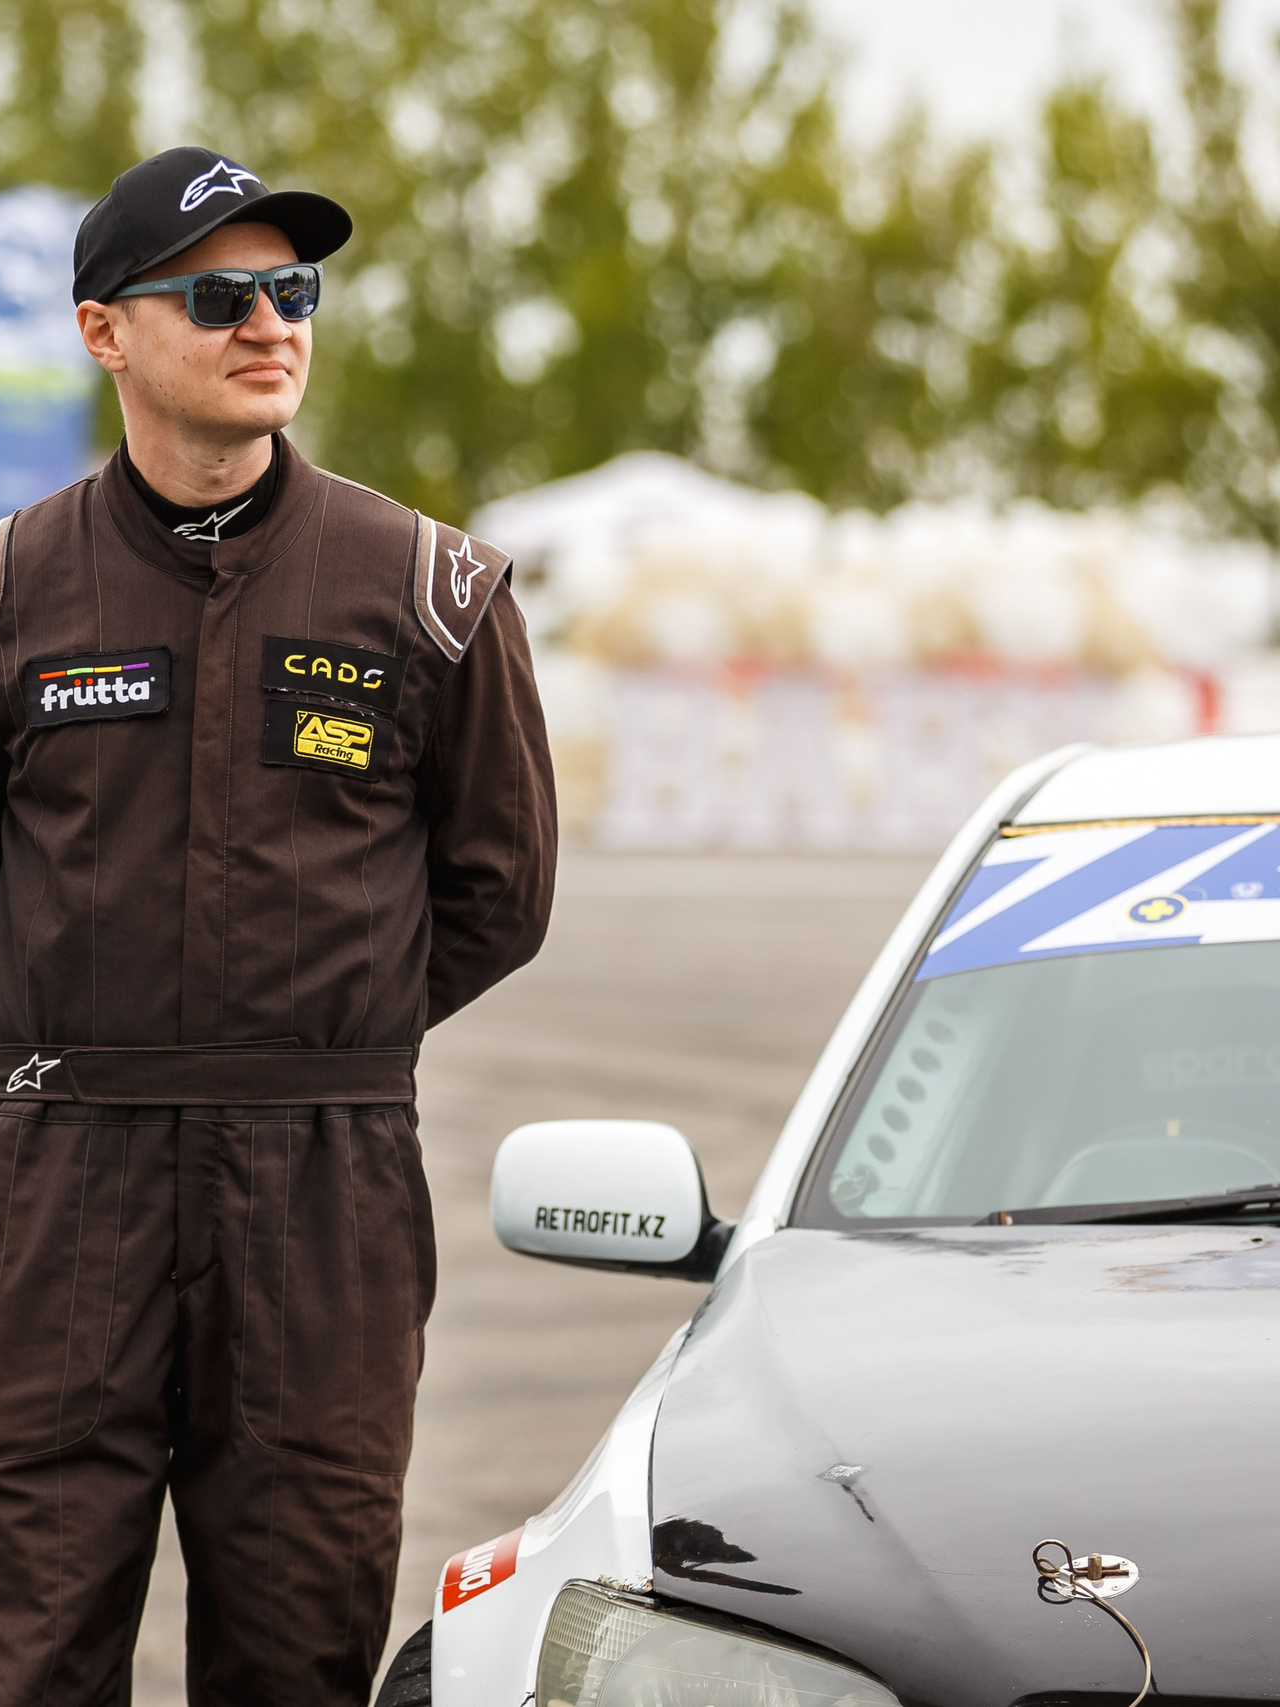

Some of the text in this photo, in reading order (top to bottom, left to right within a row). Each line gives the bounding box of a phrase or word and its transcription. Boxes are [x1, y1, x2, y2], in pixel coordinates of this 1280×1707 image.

[284, 654, 384, 690] CADS
[40, 677, 150, 712] frütta
[298, 715, 371, 748] ASP
[314, 743, 354, 762] Racing
[535, 1206, 666, 1239] RETROFIT.KZ
